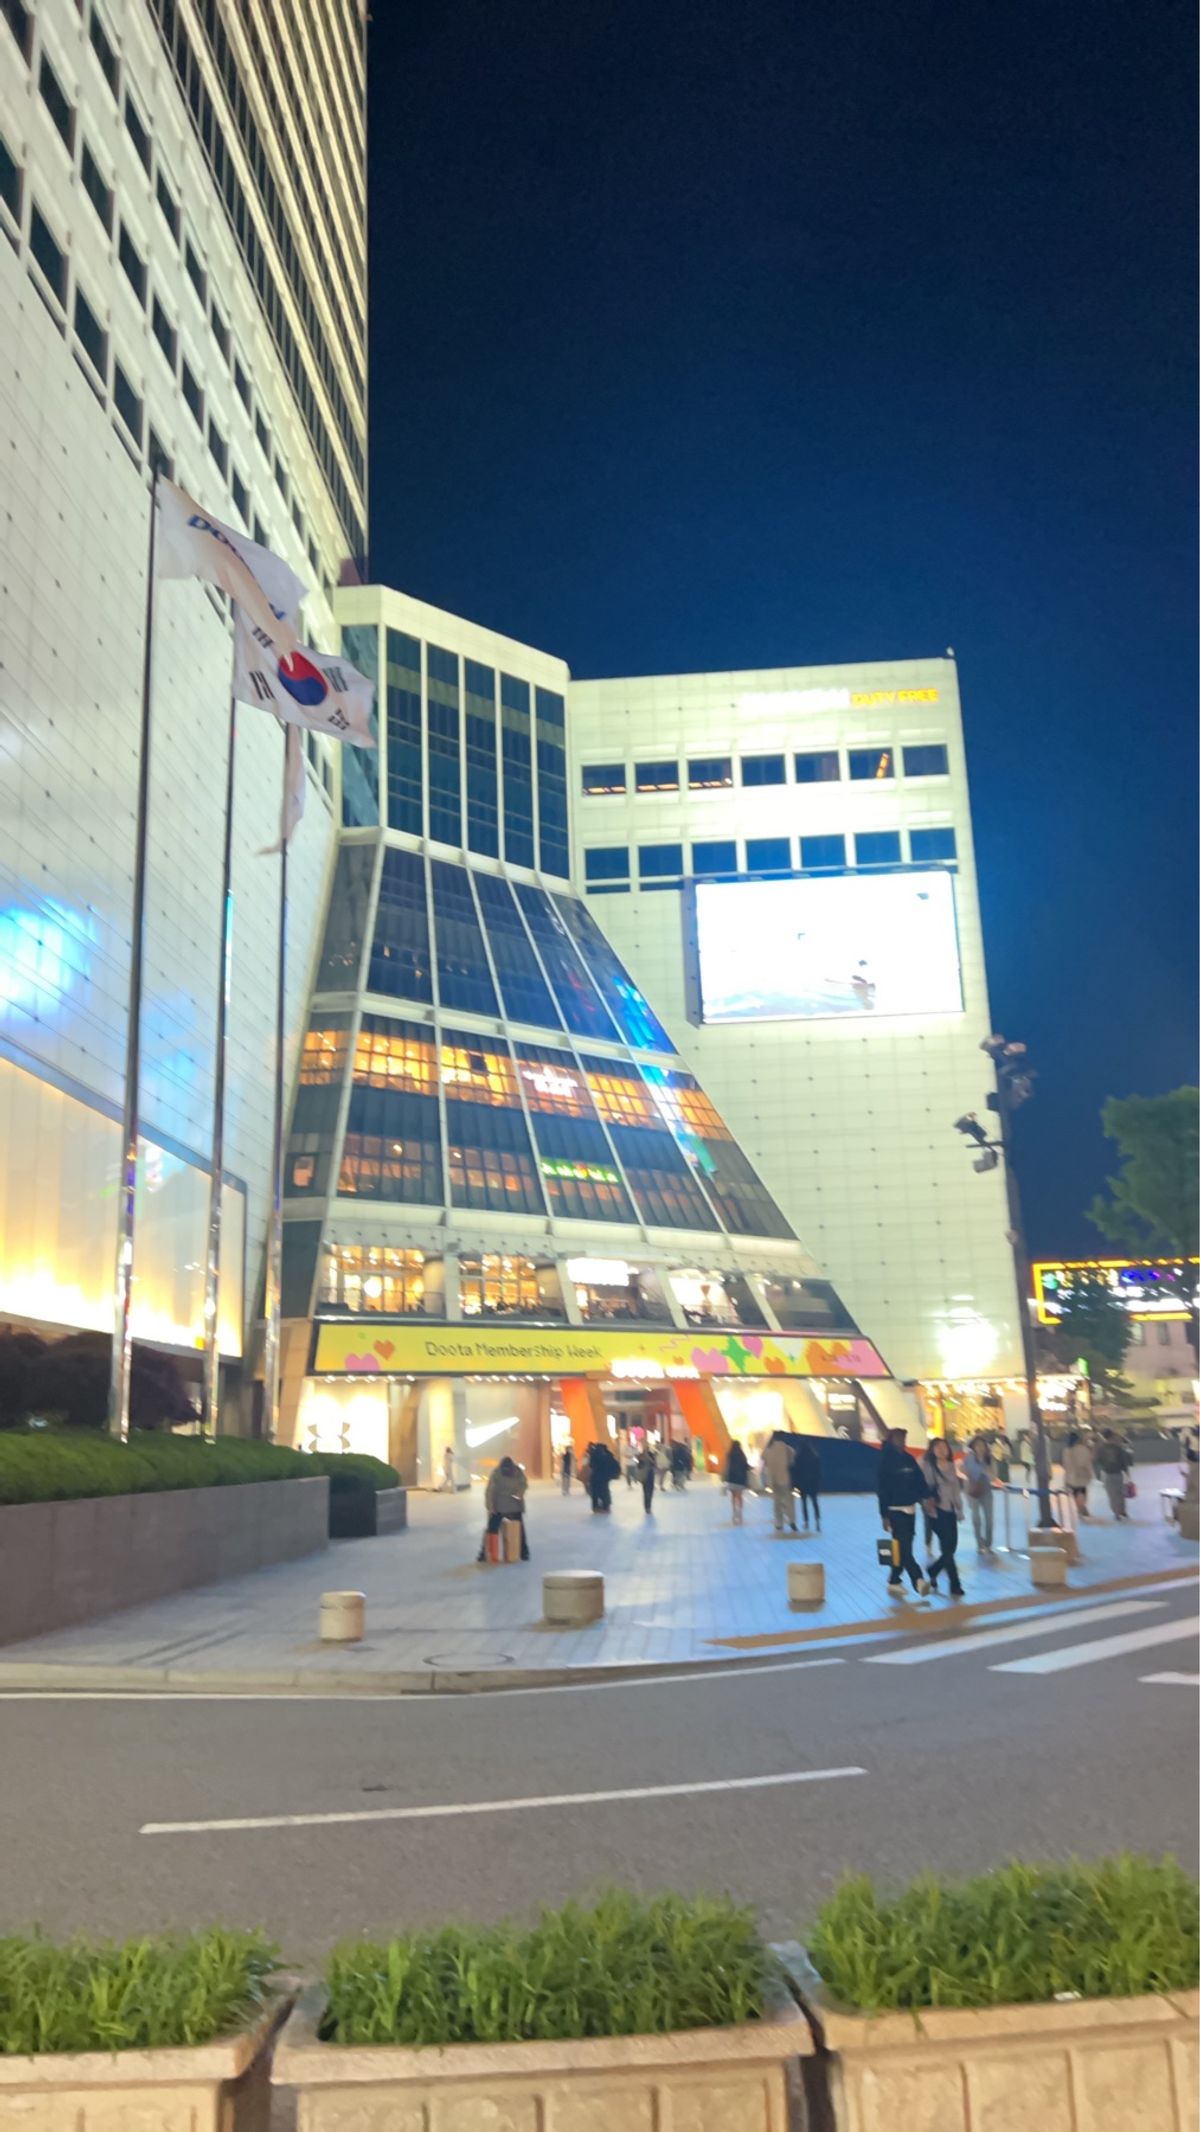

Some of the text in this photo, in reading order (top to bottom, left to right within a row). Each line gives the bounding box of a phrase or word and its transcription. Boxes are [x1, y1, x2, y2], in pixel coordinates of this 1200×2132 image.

[853, 691, 896, 706] DUTY
[898, 688, 938, 702] FREE
[425, 1341, 602, 1359] Doota Membership Week
